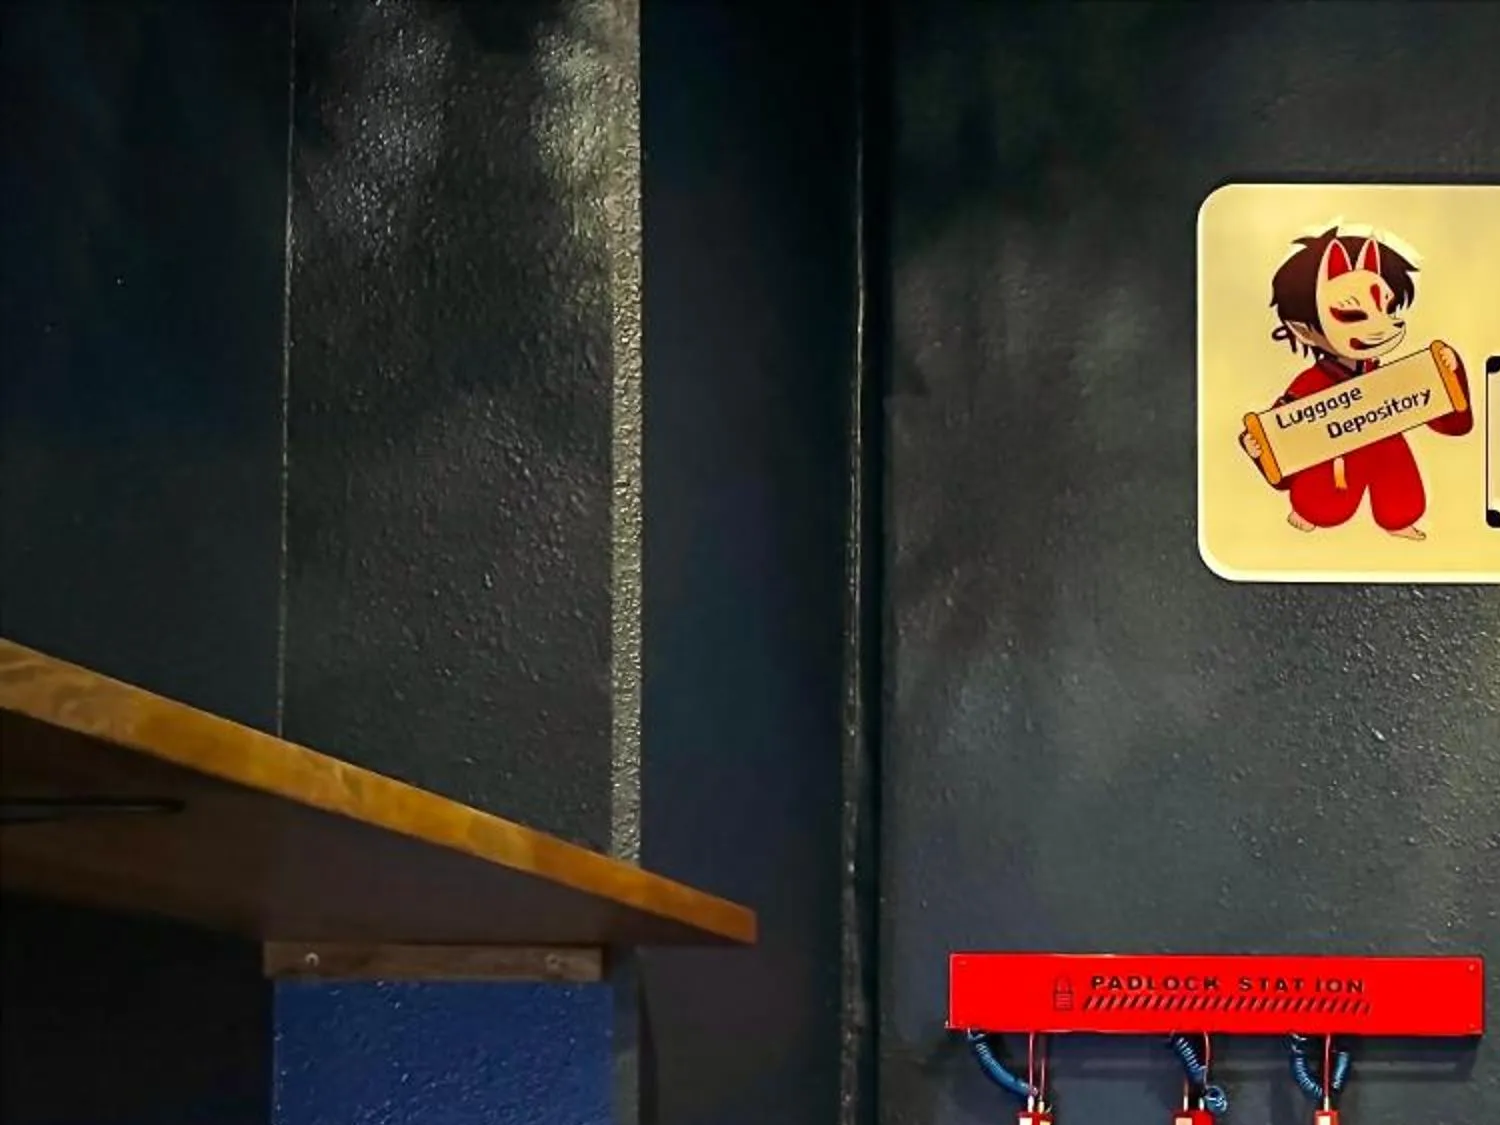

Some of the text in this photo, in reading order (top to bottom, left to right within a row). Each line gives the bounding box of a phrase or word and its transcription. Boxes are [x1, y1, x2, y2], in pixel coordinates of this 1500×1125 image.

[1275, 387, 1363, 429] Luggage
[1326, 388, 1431, 439] Depository
[1090, 975, 1364, 993] PADLOCK STATION
